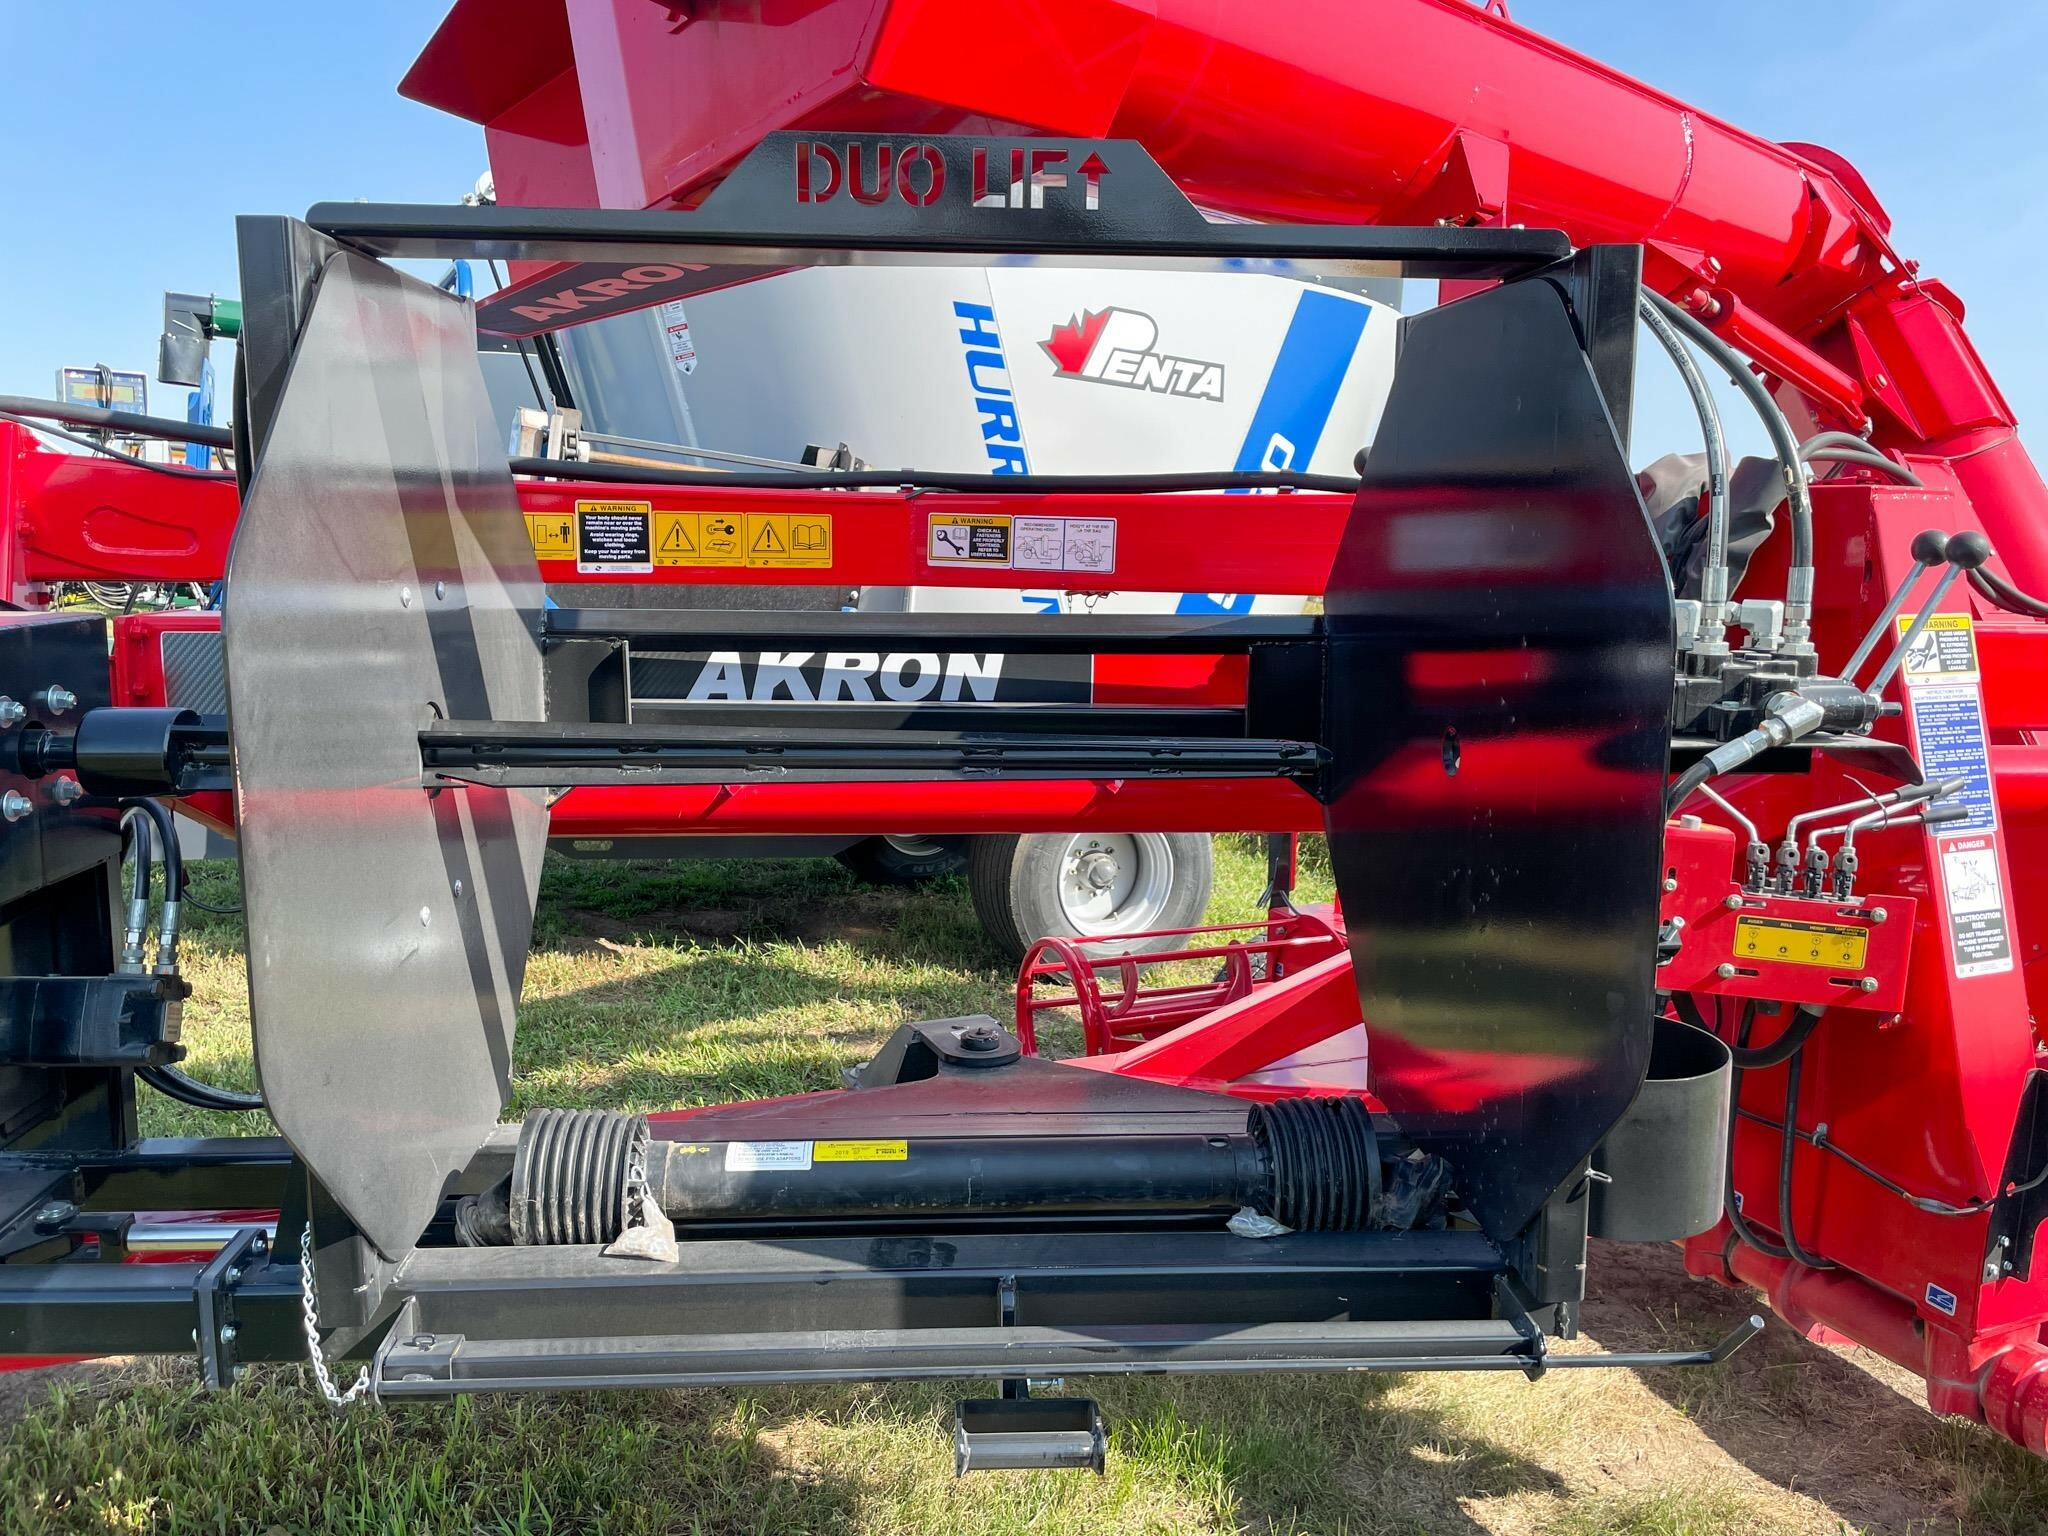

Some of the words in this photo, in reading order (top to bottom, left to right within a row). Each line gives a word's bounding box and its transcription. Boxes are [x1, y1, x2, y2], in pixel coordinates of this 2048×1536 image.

[796, 142, 946, 208] DUO
[1081, 306, 1226, 403] PENTA
[960, 517, 994, 525] WARNING
[686, 650, 1005, 702] AKRON
[1957, 839, 1986, 850] DANGER
[1954, 911, 2001, 924] ELECTROCUTION
